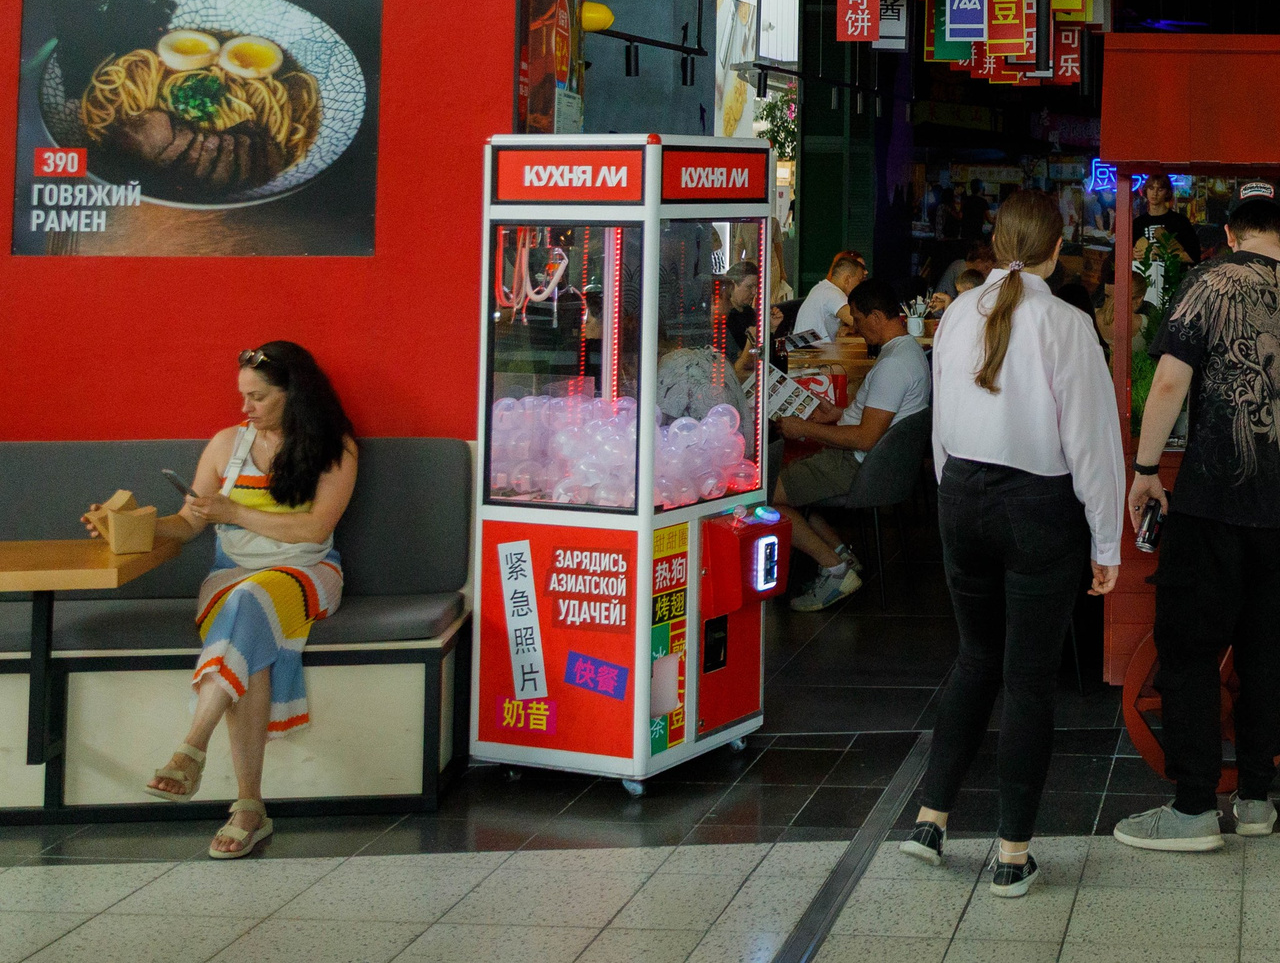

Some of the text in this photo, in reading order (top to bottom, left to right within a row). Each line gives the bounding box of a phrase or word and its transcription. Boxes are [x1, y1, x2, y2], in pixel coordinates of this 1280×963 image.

[42, 152, 80, 174] 390
[524, 165, 628, 187] КУХНЯ ЛИ
[681, 167, 749, 188] КУХНЯ ЛИ
[31, 179, 142, 207] ГОВЯЖИЙ
[30, 210, 107, 233] РАМЕН
[555, 549, 627, 573] ЗАРЯДИСЬ
[549, 573, 627, 597] АЗИАТСКОЙ
[654, 557, 686, 590] 热狗
[558, 598, 627, 626] УДАЧЕЙ!
[502, 698, 550, 731] 奶昔
